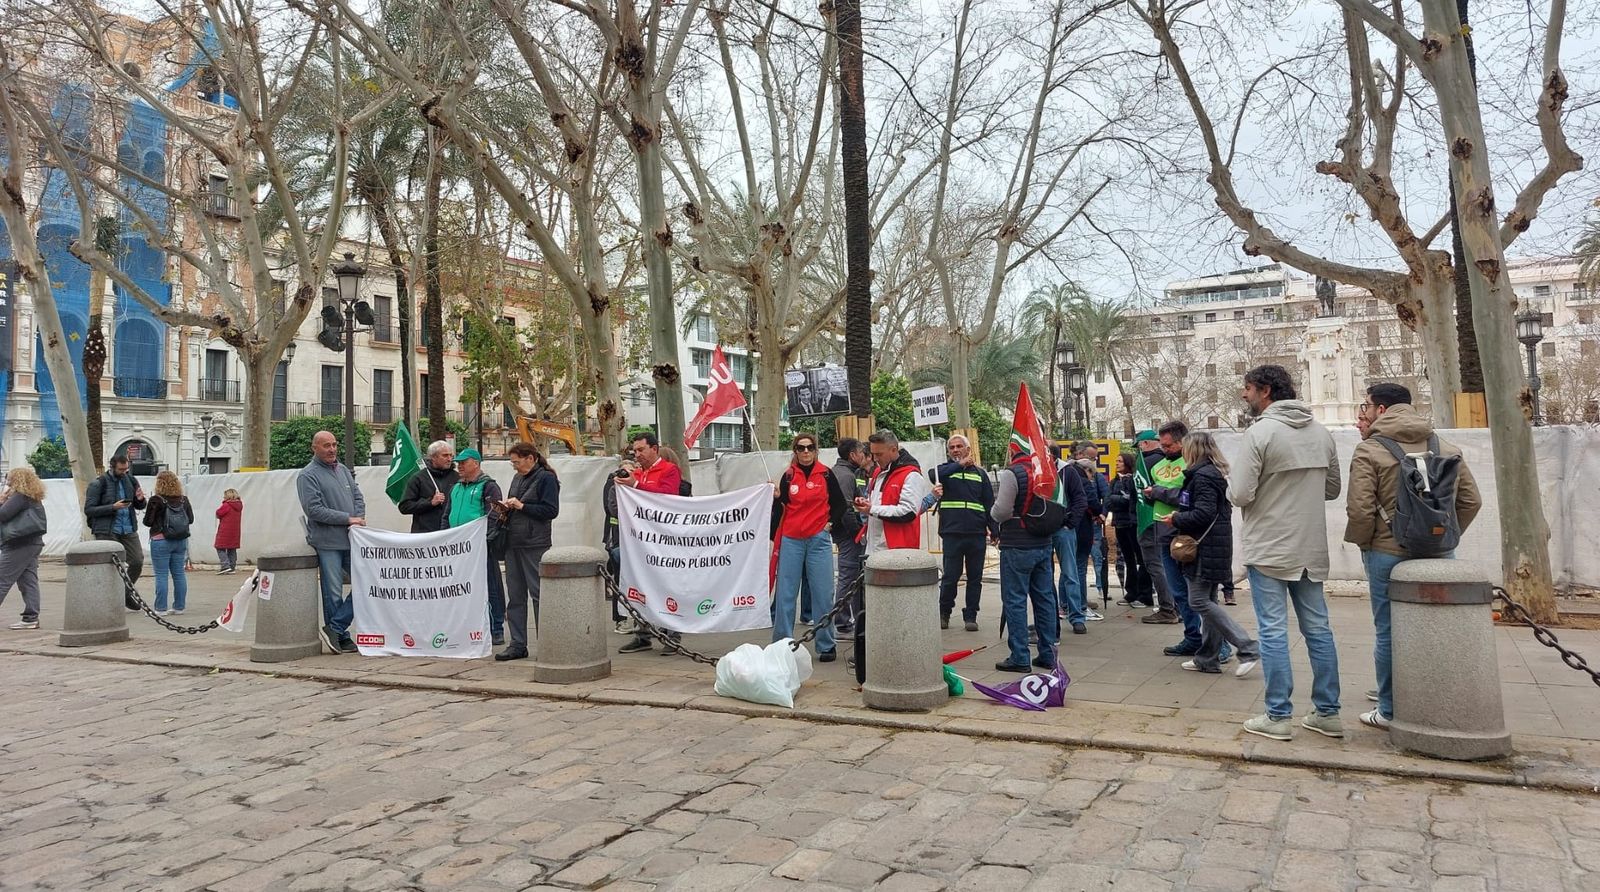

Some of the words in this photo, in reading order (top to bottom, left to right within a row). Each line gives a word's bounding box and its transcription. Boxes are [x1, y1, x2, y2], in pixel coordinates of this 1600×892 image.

[926, 406, 940, 417] PARO
[633, 505, 681, 525] ALCALDE
[682, 507, 749, 525] EMBUSTERO
[637, 530, 643, 542] A
[645, 532, 656, 543] LA
[658, 533, 721, 548] PRIVATIZACIÓN
[723, 534, 734, 545] DE
[736, 529, 755, 543] LOS
[414, 547, 427, 559] DE
[427, 546, 439, 559] LO
[646, 553, 686, 569] COLEGIOS
[688, 554, 732, 569] PÚBLICOS
[379, 567, 411, 580] ALCALDE
[413, 567, 423, 580] DE
[424, 564, 453, 579] SEVILLA
[398, 587, 408, 600] DE
[439, 581, 471, 599] MORENO
[732, 595, 756, 606] USO
